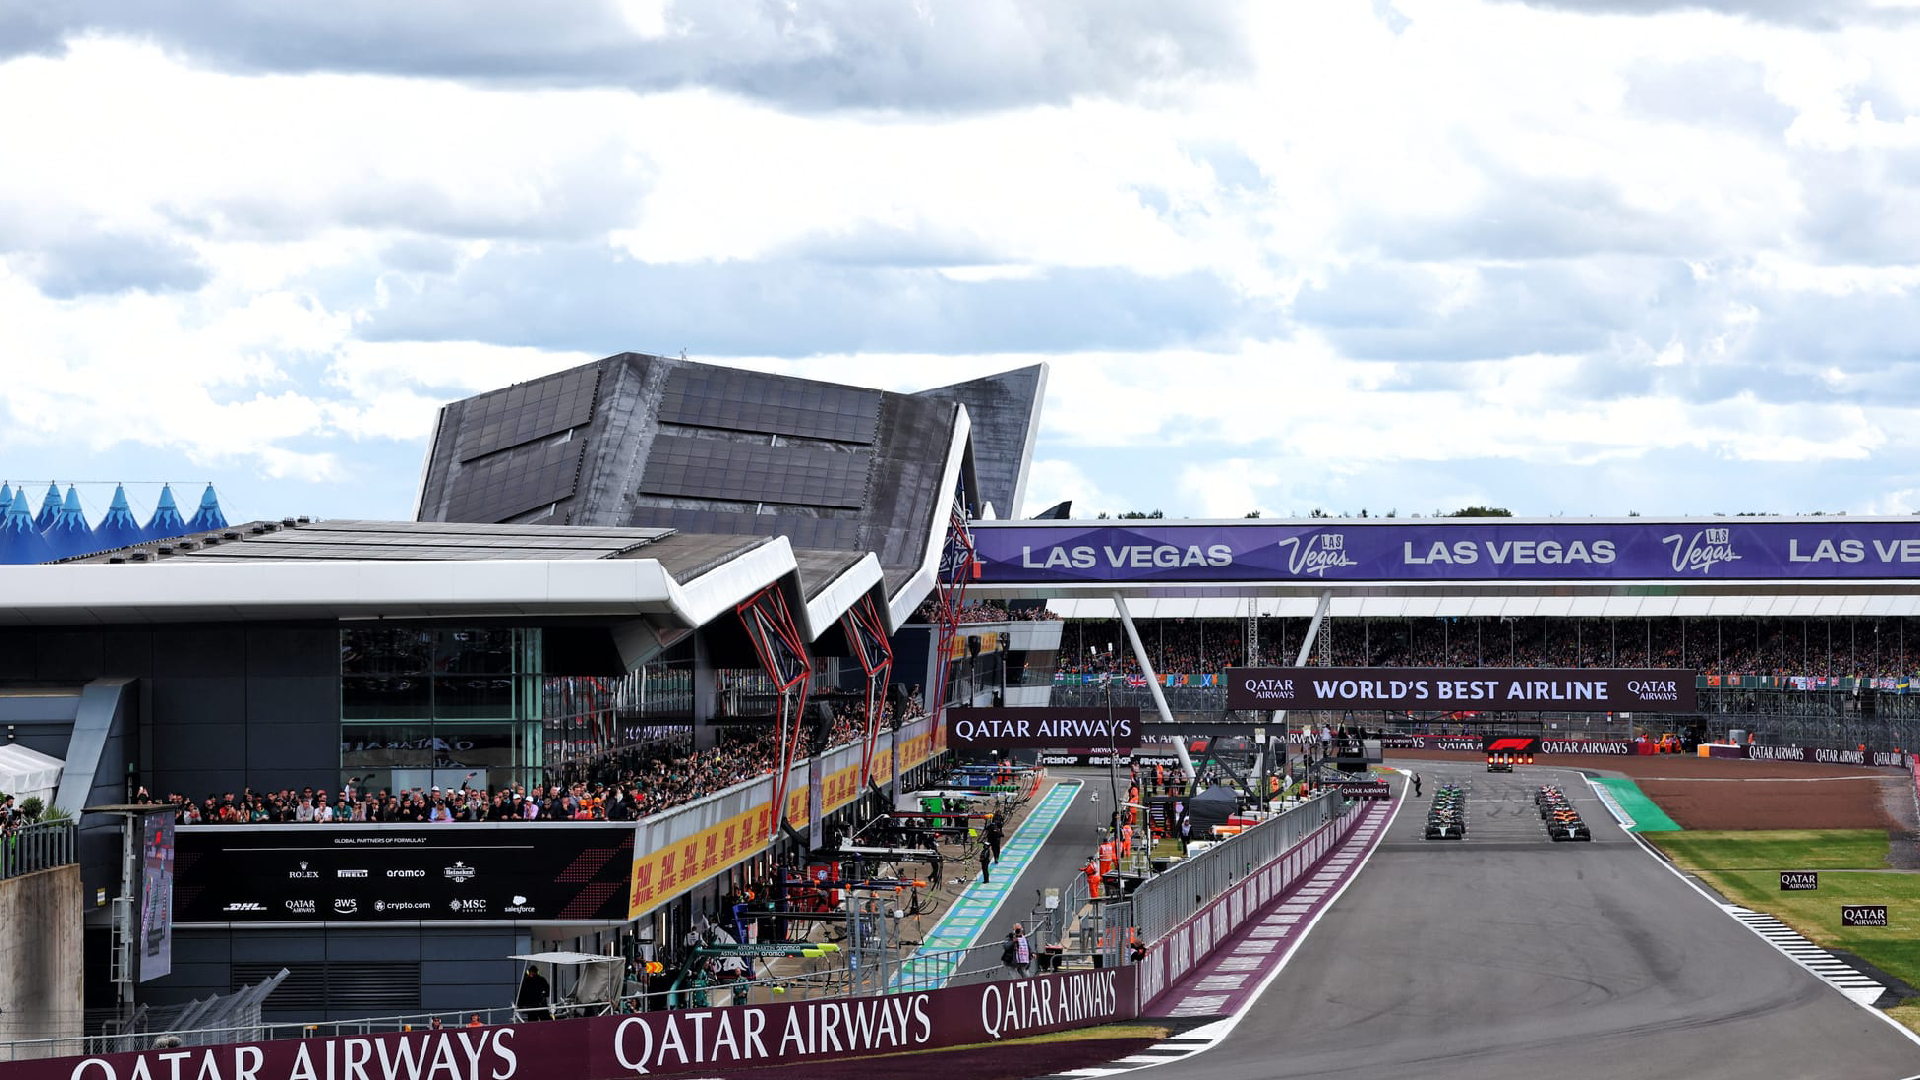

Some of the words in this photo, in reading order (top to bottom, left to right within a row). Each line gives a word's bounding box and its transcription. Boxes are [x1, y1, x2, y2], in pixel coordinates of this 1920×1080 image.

[1322, 535, 1342, 548] LAS
[1708, 529, 1727, 542] LAS
[1023, 546, 1097, 568] LAS
[1104, 545, 1233, 568] VEGAS
[1279, 535, 1358, 577] Vegas
[1405, 541, 1478, 564] LAS
[1486, 541, 1616, 564] VEGAS
[1662, 531, 1742, 574] Vegas
[1790, 539, 1864, 562] LAS
[1246, 680, 1294, 692] QATAR
[1436, 681, 1499, 700] BEST
[1507, 682, 1608, 700] AIRLINE
[1628, 680, 1676, 694] QATAR
[1256, 690, 1294, 699] AIRWAYS
[1640, 692, 1678, 700] AIRWAYS
[956, 720, 1031, 742] QATAR
[1036, 720, 1132, 737] AIRWAYS
[1542, 742, 1578, 754] QATAR
[1580, 742, 1628, 754] AIRWAYS
[1748, 746, 1773, 760] QATAR
[1774, 746, 1804, 760] AIRWAYS
[1816, 748, 1838, 762] QATAR
[387, 870, 426, 878] aramco
[1782, 874, 1816, 884] QATAR
[227, 903, 264, 911] DHL
[286, 900, 315, 909] QATAR
[334, 899, 356, 907] aws
[386, 902, 430, 910] crypto.com
[462, 900, 486, 908] MSC
[1844, 909, 1885, 920] QATAR
[982, 978, 1054, 1039] QATAR
[1058, 970, 1116, 1024] AIRWAYS
[614, 1009, 769, 1074] QATAR
[778, 994, 931, 1056] AIRWAYS
[289, 1028, 517, 1080] AIRWAYS
